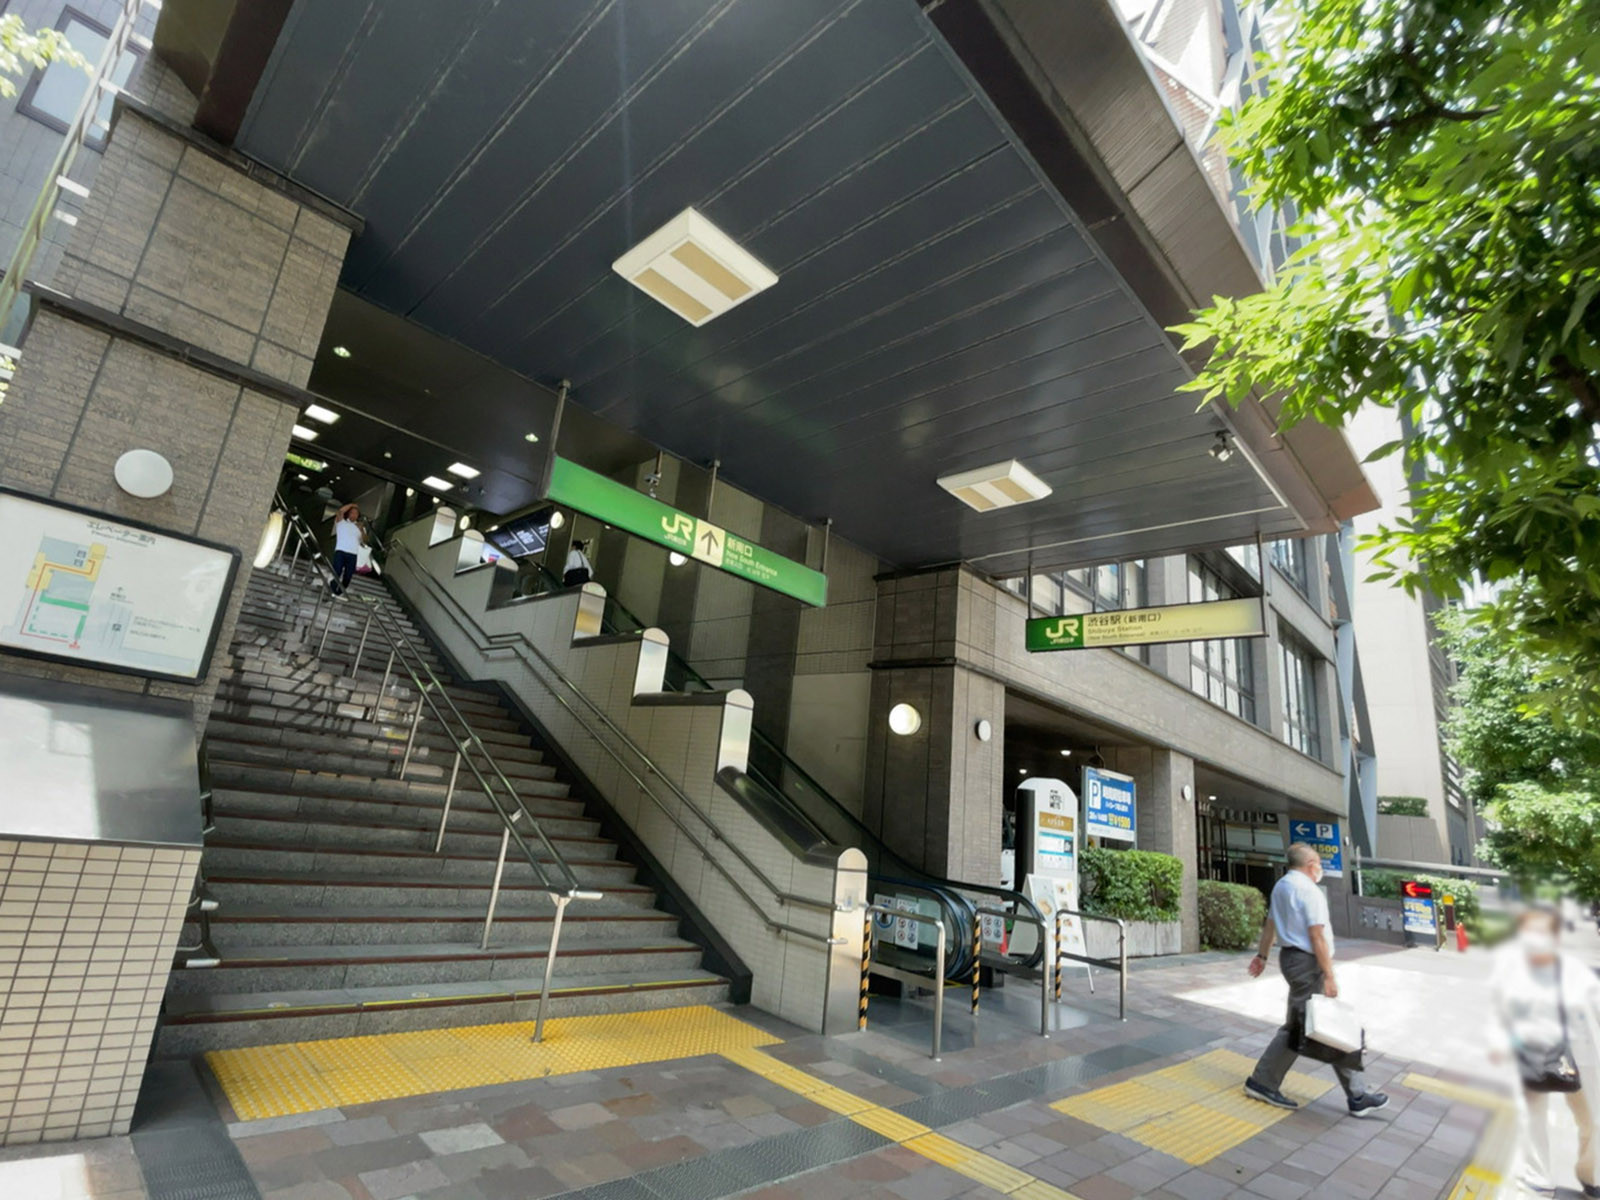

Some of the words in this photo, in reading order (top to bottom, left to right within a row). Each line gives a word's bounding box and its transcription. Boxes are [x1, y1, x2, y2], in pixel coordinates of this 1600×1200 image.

[661, 513, 694, 541] JR
[1045, 618, 1079, 639] JR
[1117, 625, 1142, 633] Station
[1091, 782, 1099, 806] P
[1319, 825, 1329, 836] P
